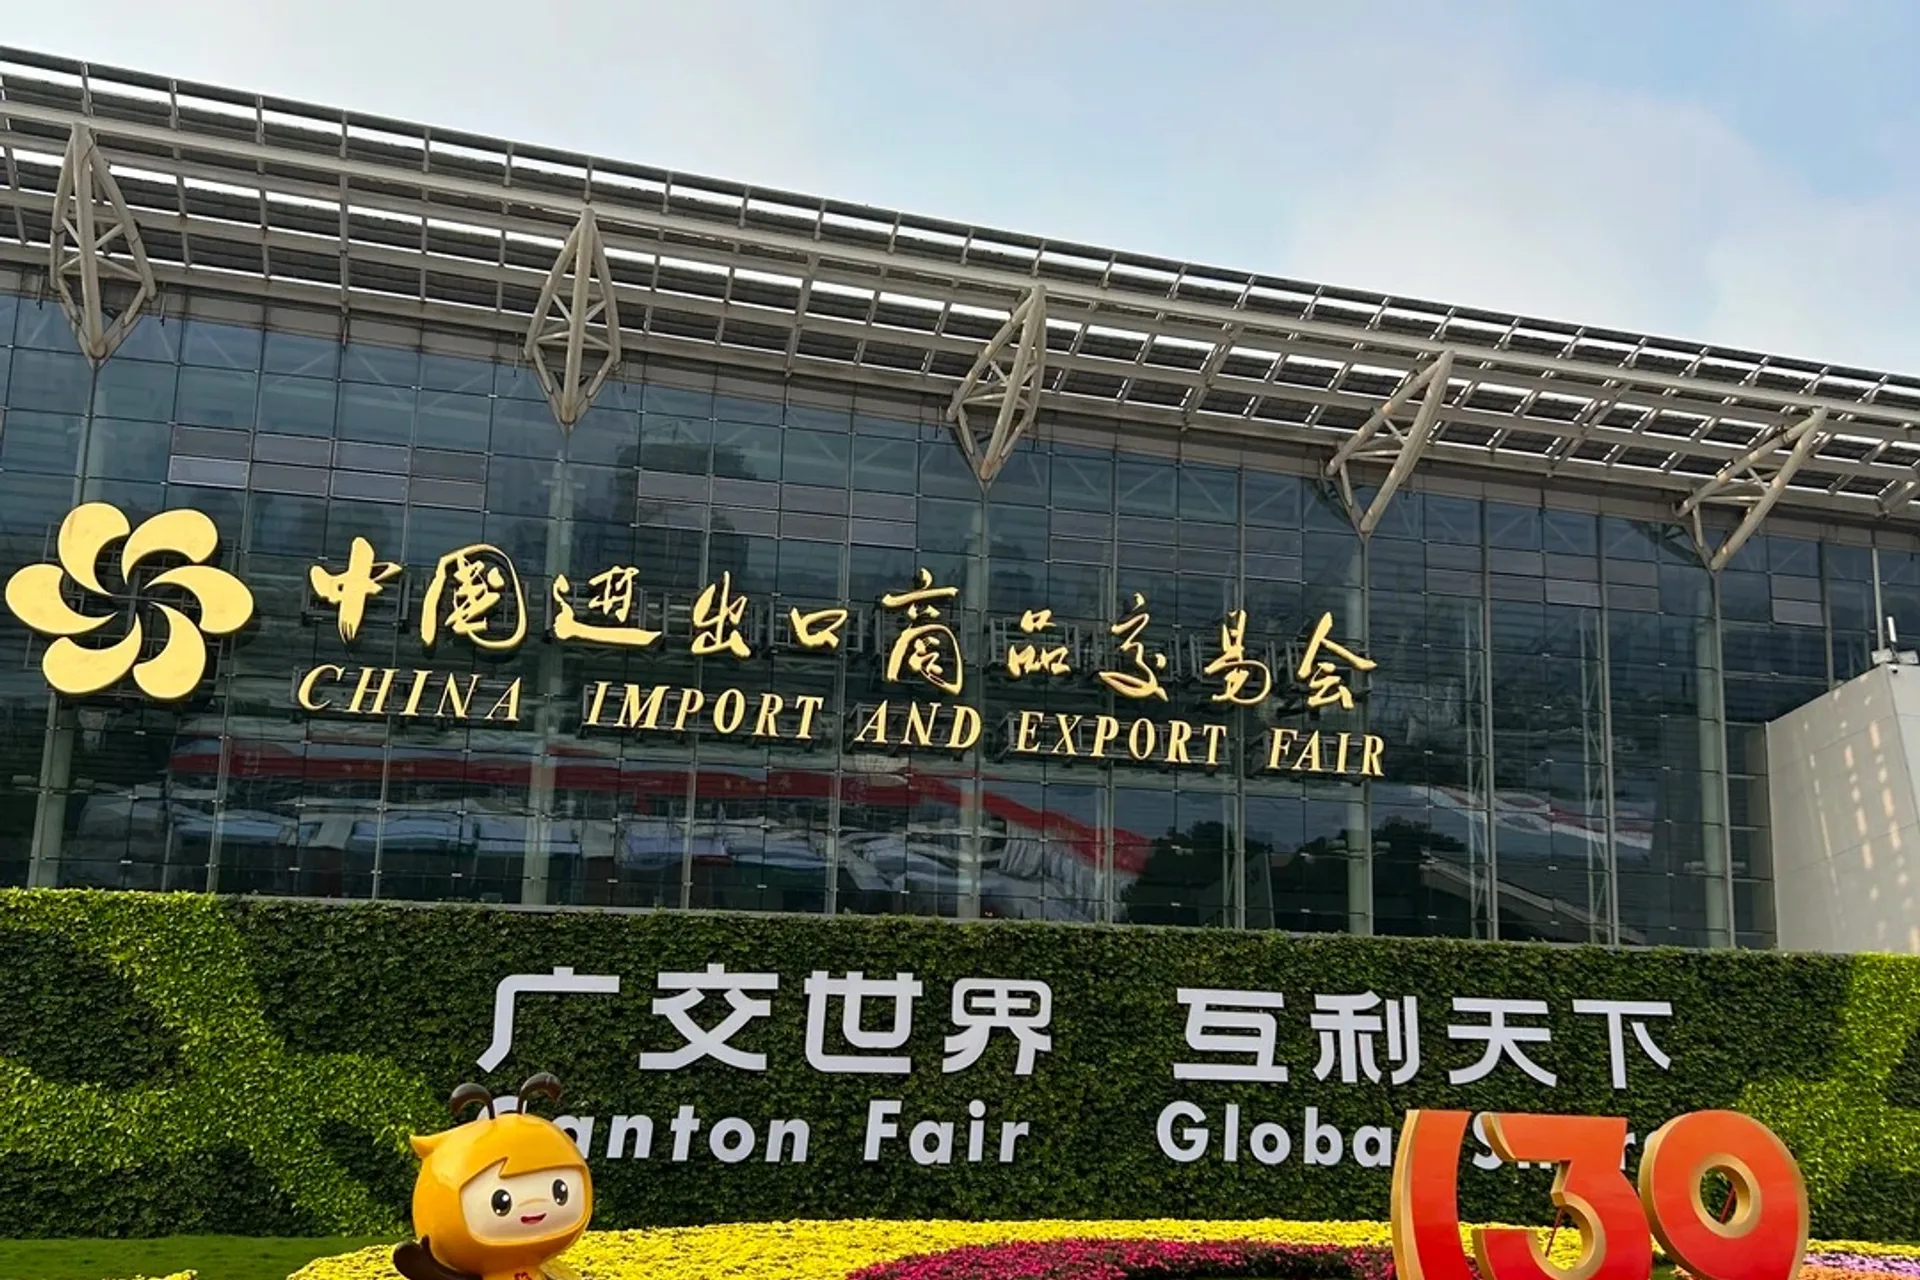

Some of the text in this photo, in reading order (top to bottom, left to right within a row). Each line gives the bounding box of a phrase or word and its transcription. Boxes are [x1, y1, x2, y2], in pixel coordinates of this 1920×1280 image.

[297, 663, 1387, 777] CHINA IMPORT AND EXPORT FAIR
[475, 962, 1674, 1090] 广交世界 互利天下
[476, 1095, 812, 1163] anton
[863, 1099, 1031, 1165] Fair
[1155, 1099, 1393, 1168] Globa
